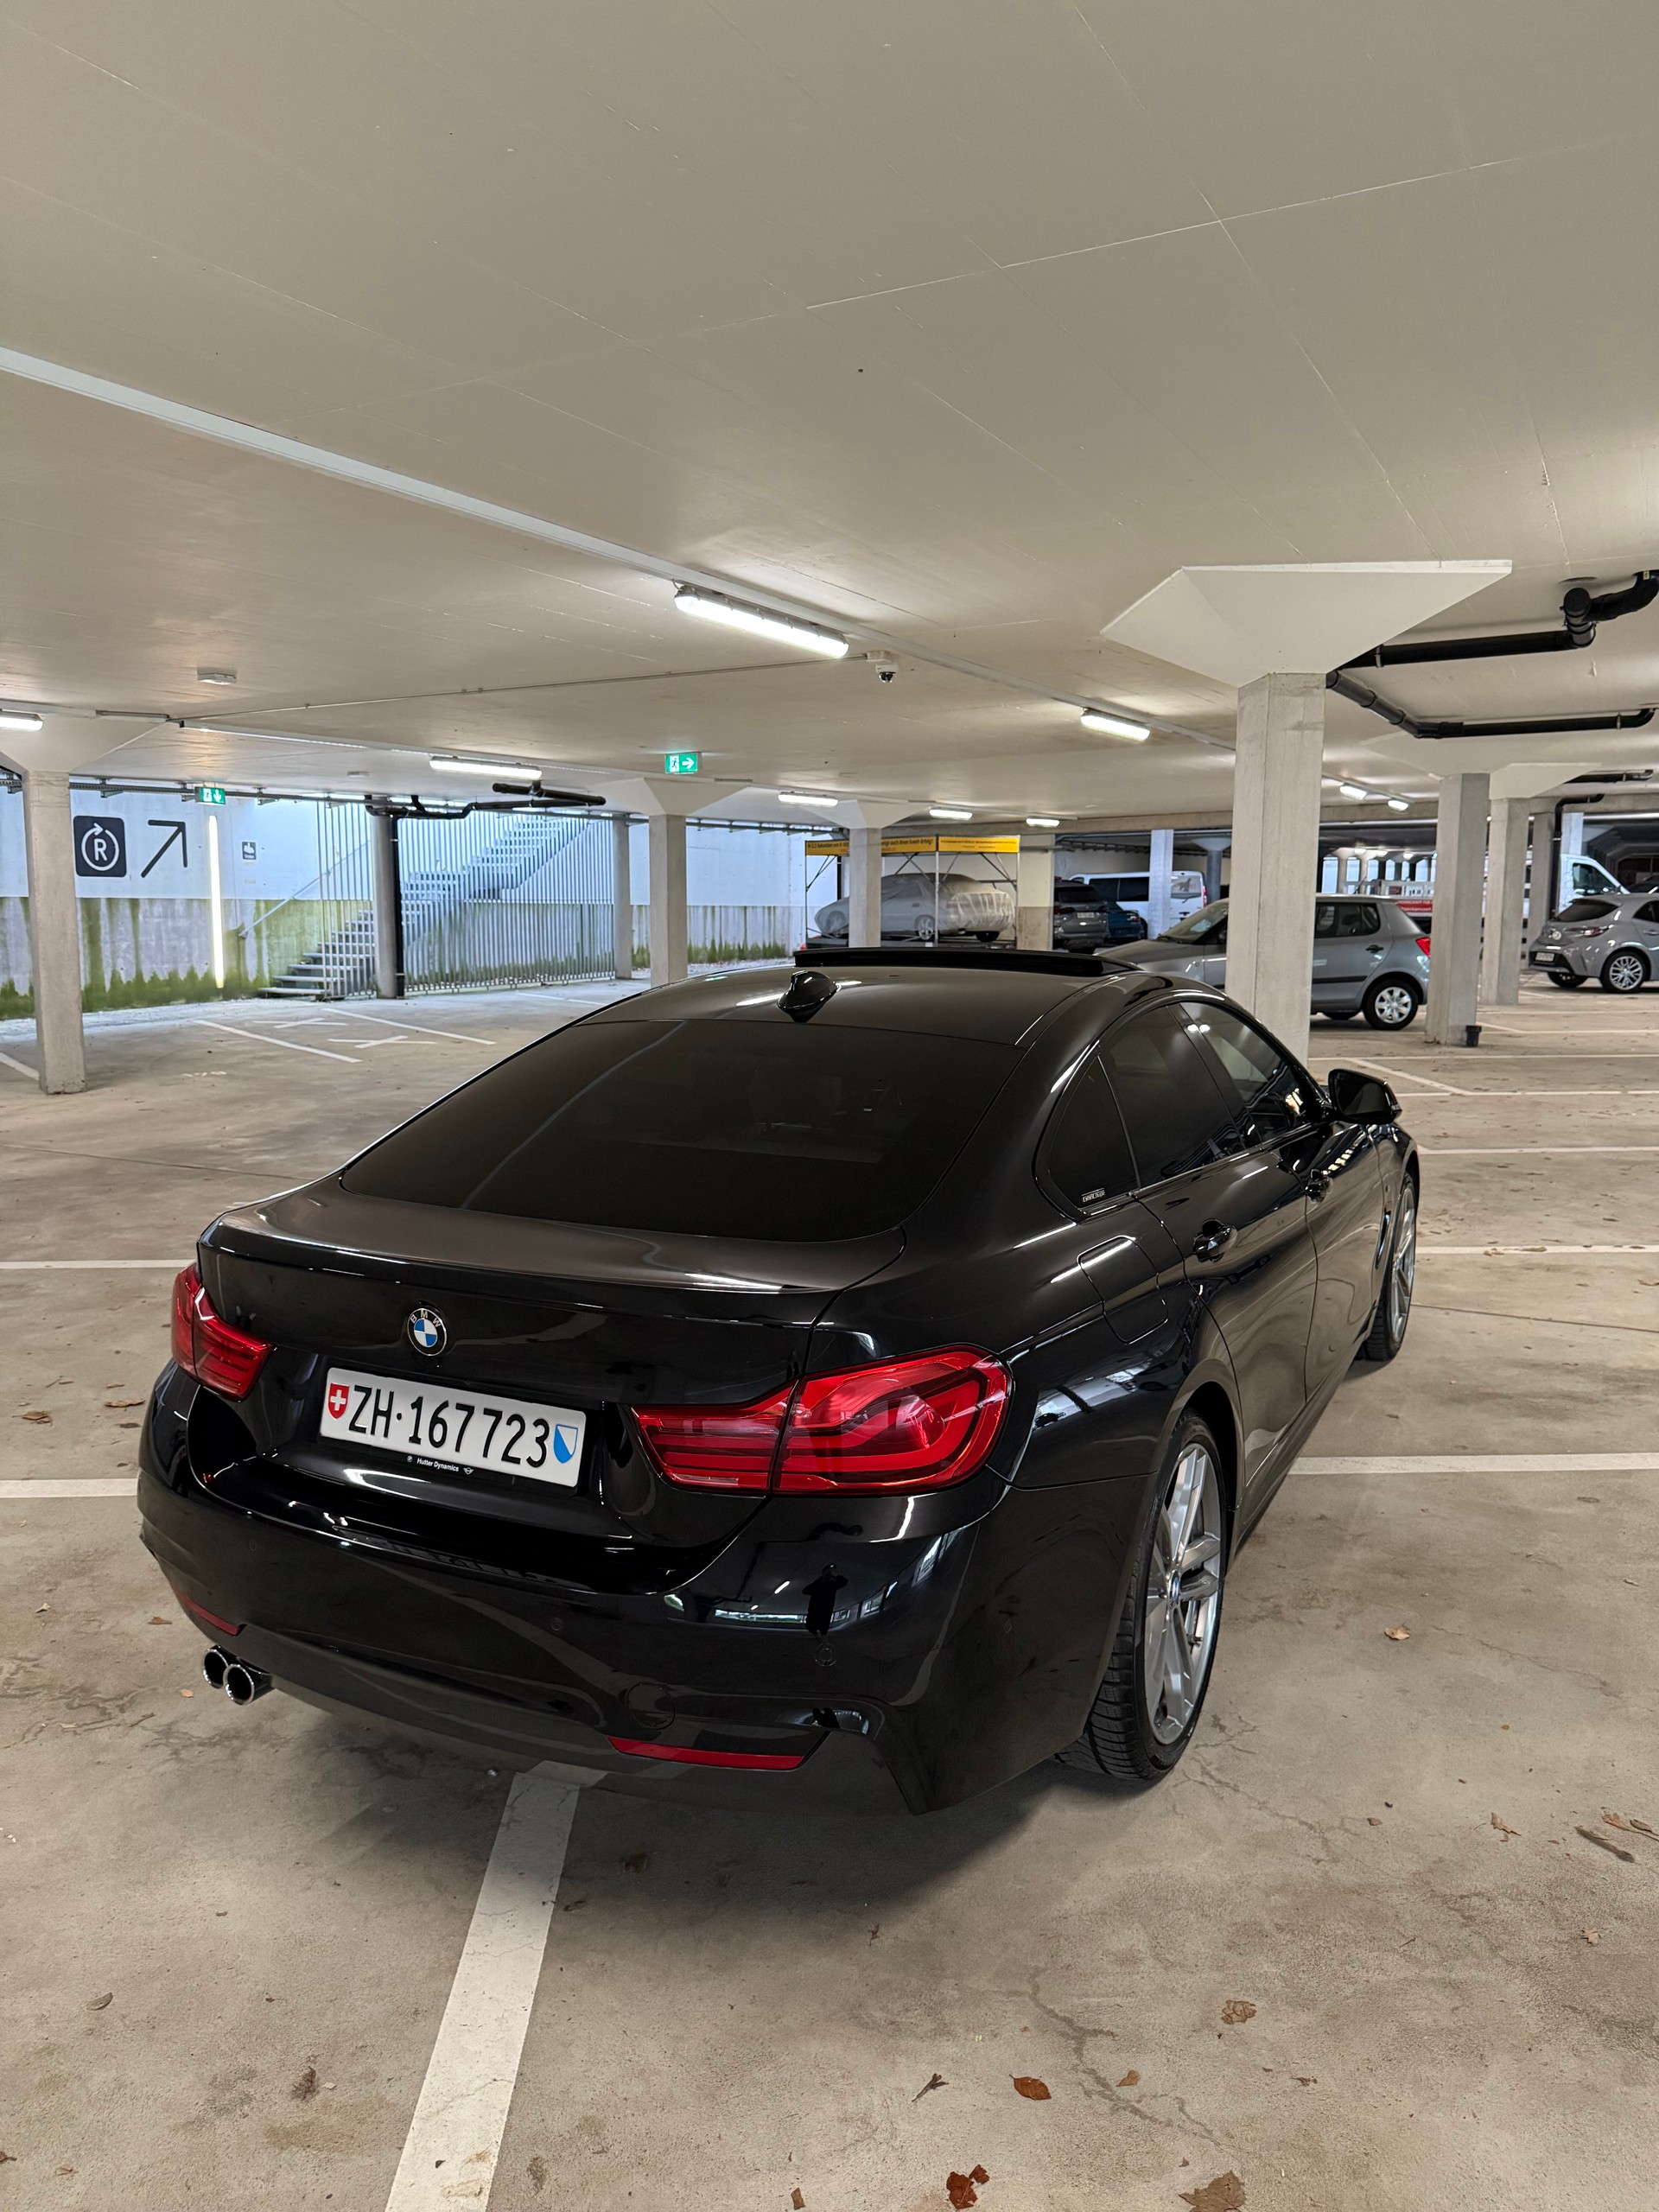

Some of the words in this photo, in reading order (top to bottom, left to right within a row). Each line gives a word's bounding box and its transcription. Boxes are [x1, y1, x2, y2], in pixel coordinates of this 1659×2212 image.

[93, 837, 108, 861] R
[410, 1309, 442, 1328] BMW
[416, 1457, 433, 1467] Hutter
[434, 1461, 460, 1472] Dynamics
